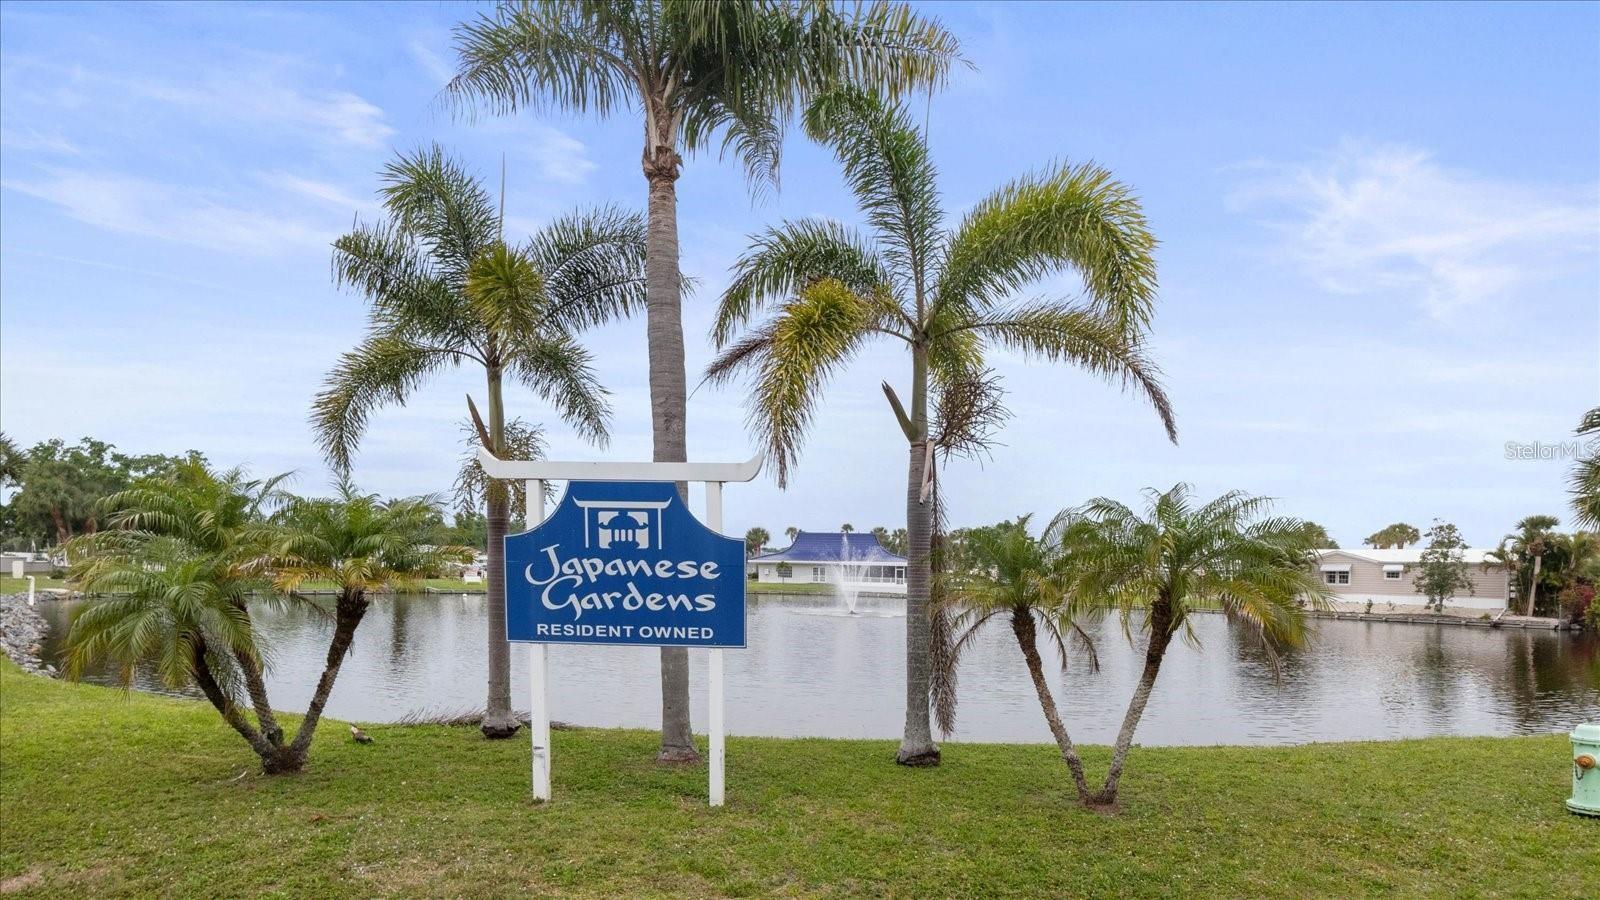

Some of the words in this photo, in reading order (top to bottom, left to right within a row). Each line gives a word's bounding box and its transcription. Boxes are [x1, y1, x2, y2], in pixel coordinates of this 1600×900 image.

[525, 544, 721, 585] Japanese
[541, 575, 716, 621] Gardens
[537, 624, 634, 638] RESIDENT
[639, 626, 714, 639] OWNED
